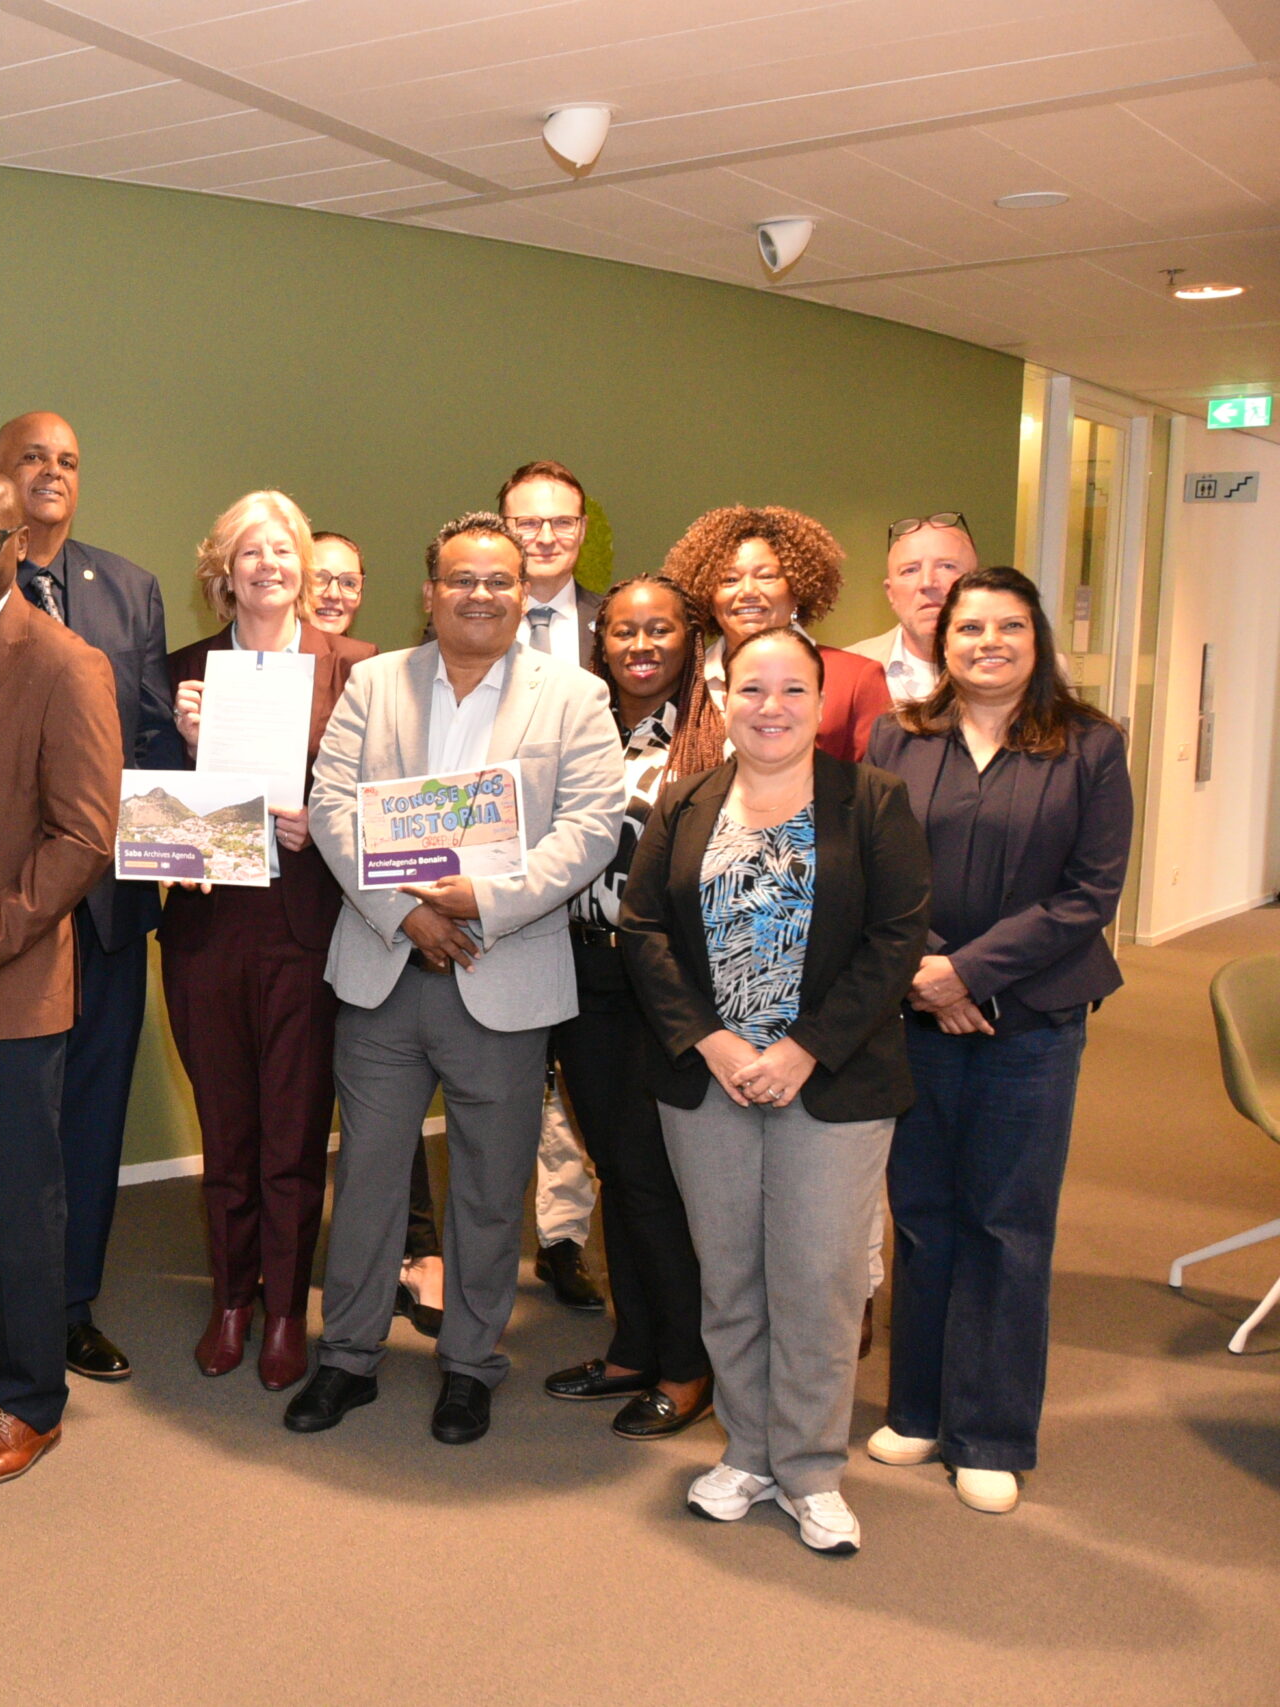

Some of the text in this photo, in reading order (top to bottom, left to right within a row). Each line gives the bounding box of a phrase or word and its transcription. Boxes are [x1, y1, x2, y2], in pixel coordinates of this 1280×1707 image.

[381, 774, 504, 814] KONOSE NOS
[390, 801, 502, 842] HISTORIA
[144, 850, 170, 858] Archives
[172, 852, 195, 860] Agenda
[368, 855, 448, 868] Archiefagenda Bonaire
